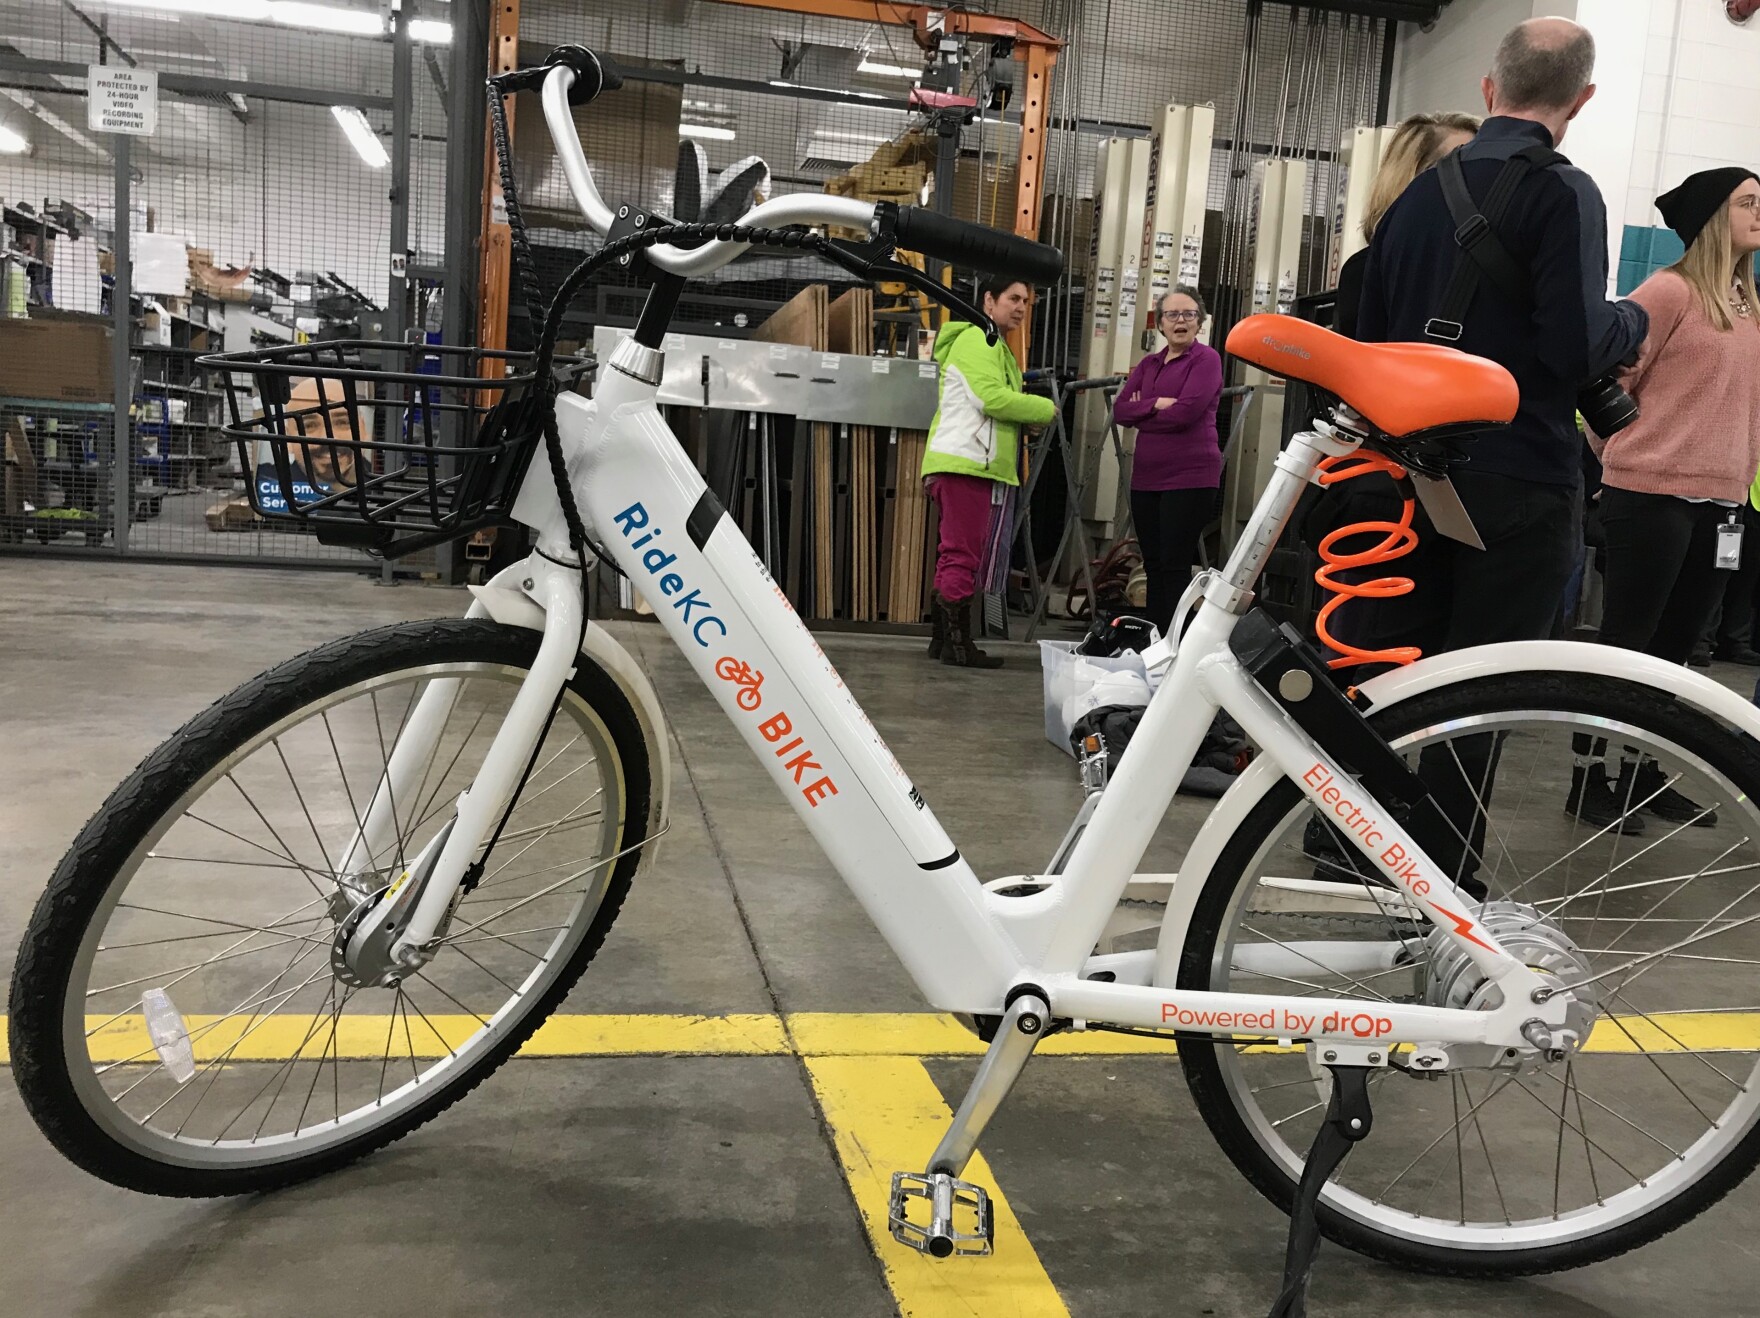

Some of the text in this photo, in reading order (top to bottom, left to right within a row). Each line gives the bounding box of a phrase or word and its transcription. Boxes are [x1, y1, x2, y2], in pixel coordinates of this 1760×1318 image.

[96, 80, 149, 92] PROTECTED BY
[107, 91, 139, 100] 24-HOUR
[112, 101, 134, 109] VIDEO
[102, 109, 144, 119] RECORDING
[102, 118, 144, 129] EQUIPMENT
[1146, 132, 1161, 207] Stertil
[613, 501, 839, 807] RideKC BIKE
[1303, 763, 1431, 897] Electric Bike
[1161, 1003, 1275, 1030] Powered
[1284, 1009, 1316, 1035] by
